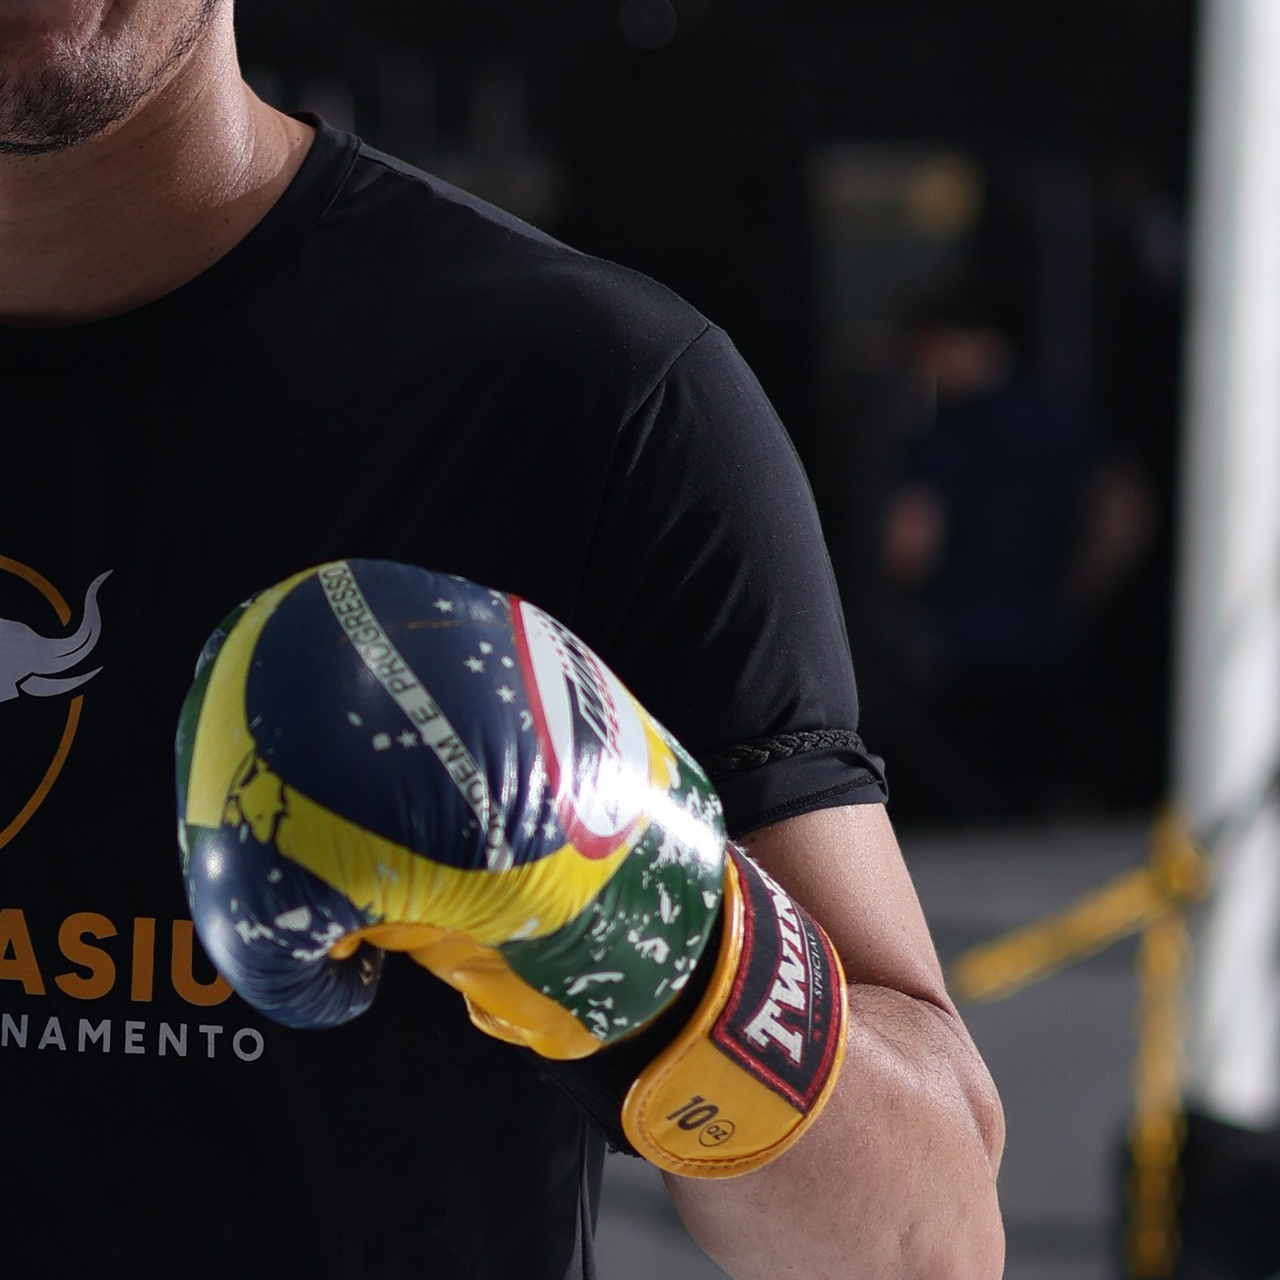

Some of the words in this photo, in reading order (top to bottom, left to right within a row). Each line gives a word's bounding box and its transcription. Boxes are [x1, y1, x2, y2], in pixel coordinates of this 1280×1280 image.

[411, 700, 439, 725] E
[738, 847, 806, 1064] TWIN
[665, 1095, 718, 1131] 10
